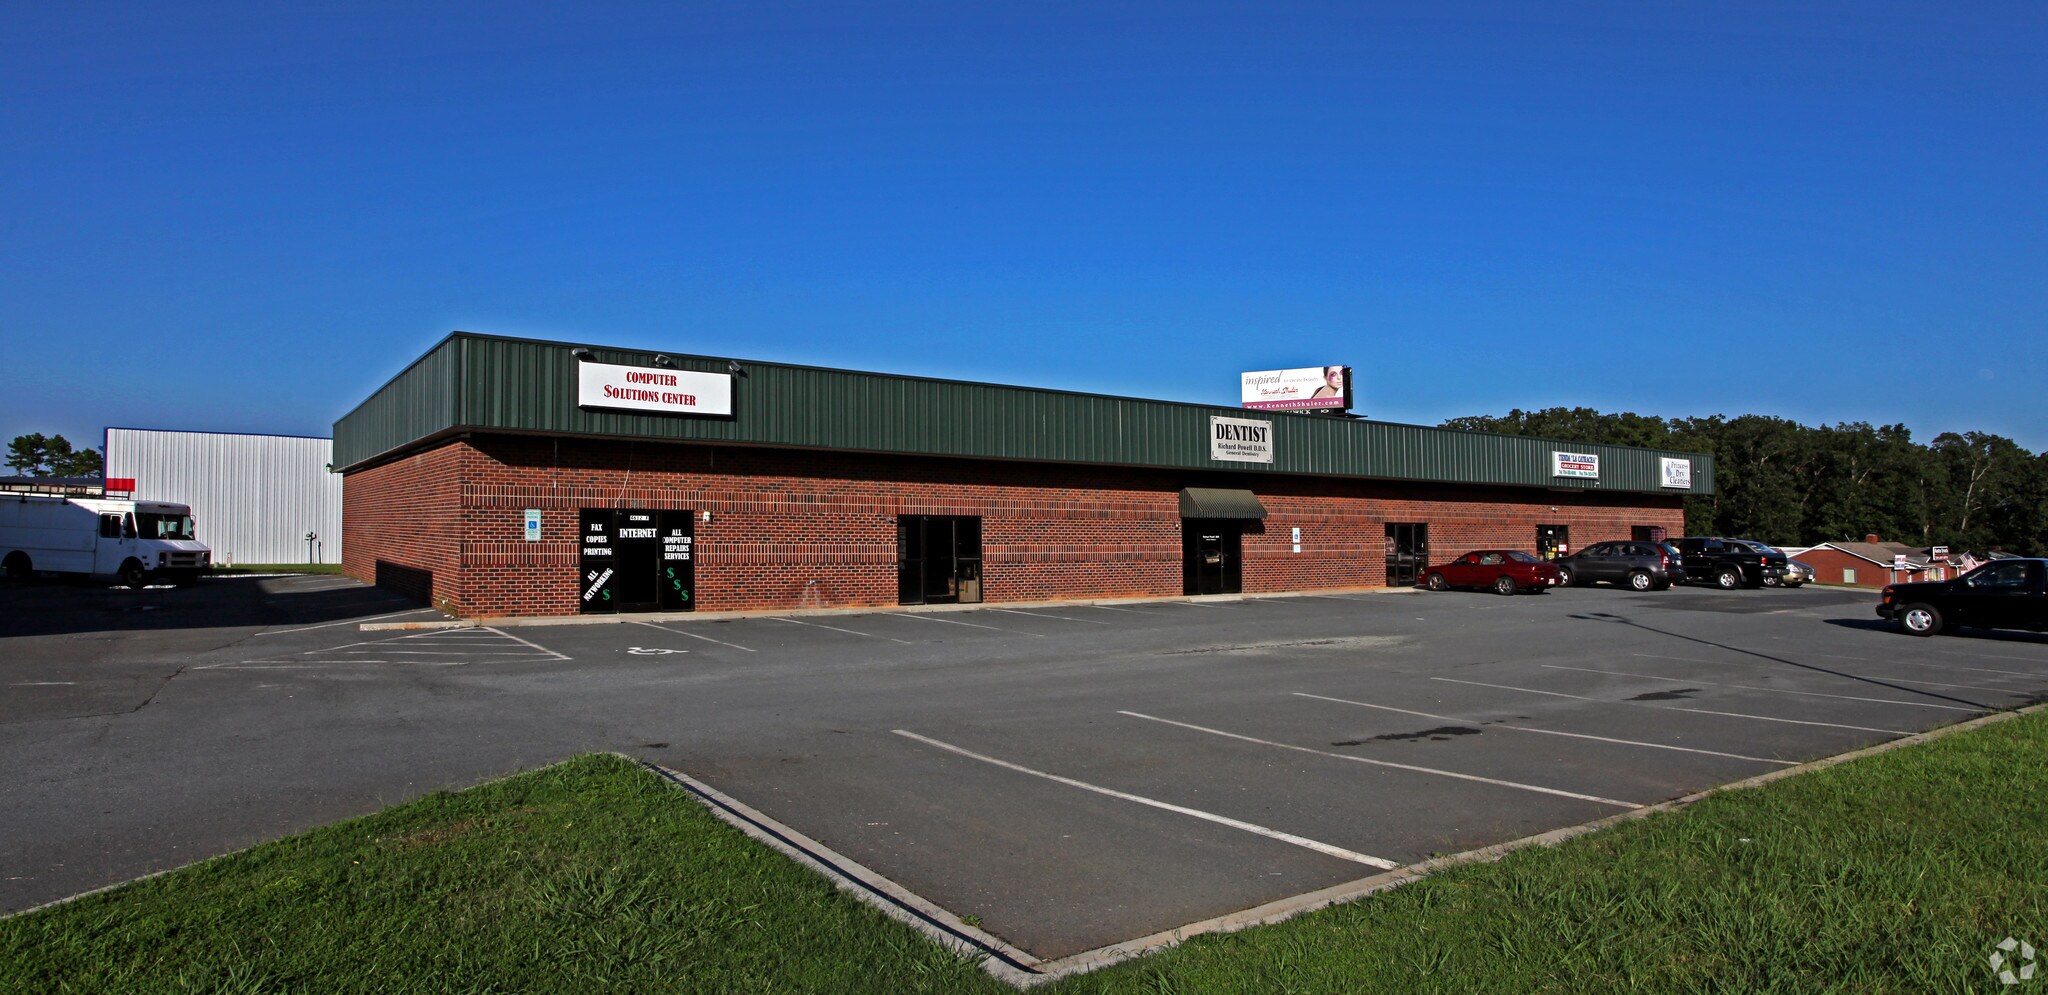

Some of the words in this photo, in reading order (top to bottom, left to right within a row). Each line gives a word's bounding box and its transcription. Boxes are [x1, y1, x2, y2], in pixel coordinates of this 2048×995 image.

[626, 371, 677, 387] COMPUTER
[1245, 370, 1283, 390] inspired
[662, 392, 696, 406] CENTER
[1216, 423, 1268, 443] DENTIST
[1217, 442, 1237, 450] Richard
[590, 523, 603, 532] FAX
[671, 528, 683, 536] ALL
[619, 528, 657, 538] INTERNET
[585, 535, 608, 543] COPIES
[583, 547, 612, 556] PRINTING
[664, 544, 690, 552] REPAIRS
[664, 552, 690, 560] SERVICES
[587, 569, 599, 582] ALL
[583, 567, 614, 602] NETWORKING
